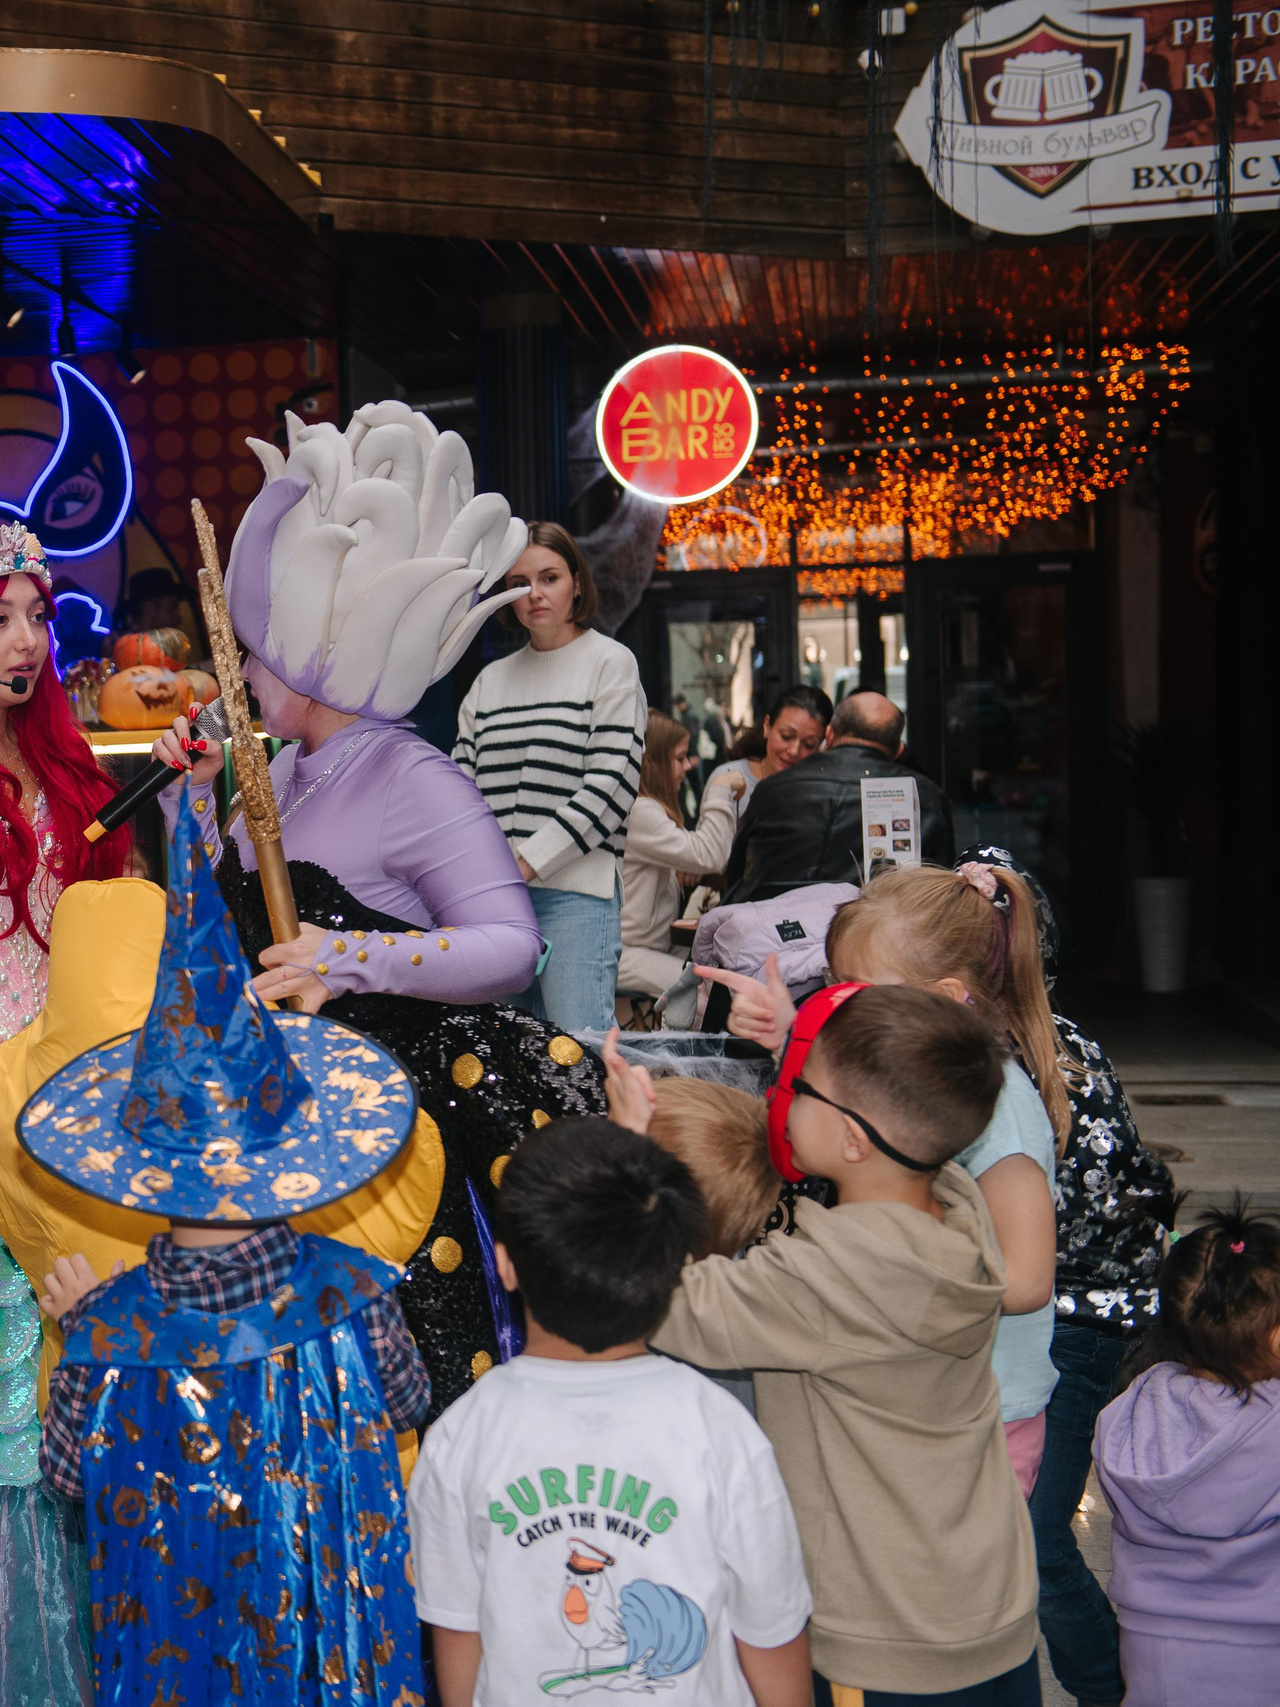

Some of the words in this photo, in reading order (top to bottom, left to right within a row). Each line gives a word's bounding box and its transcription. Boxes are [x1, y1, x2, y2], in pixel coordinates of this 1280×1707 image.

[1172, 9, 1280, 46] РЕТО
[1185, 57, 1280, 90] КРА
[1044, 117, 1147, 158] бульвар
[620, 387, 734, 426] ANDY
[622, 425, 709, 463] BAR
[488, 1464, 678, 1536] SURFING
[517, 1516, 562, 1548] CATCH
[568, 1512, 597, 1528] THE
[606, 1515, 652, 1548] WAVE
